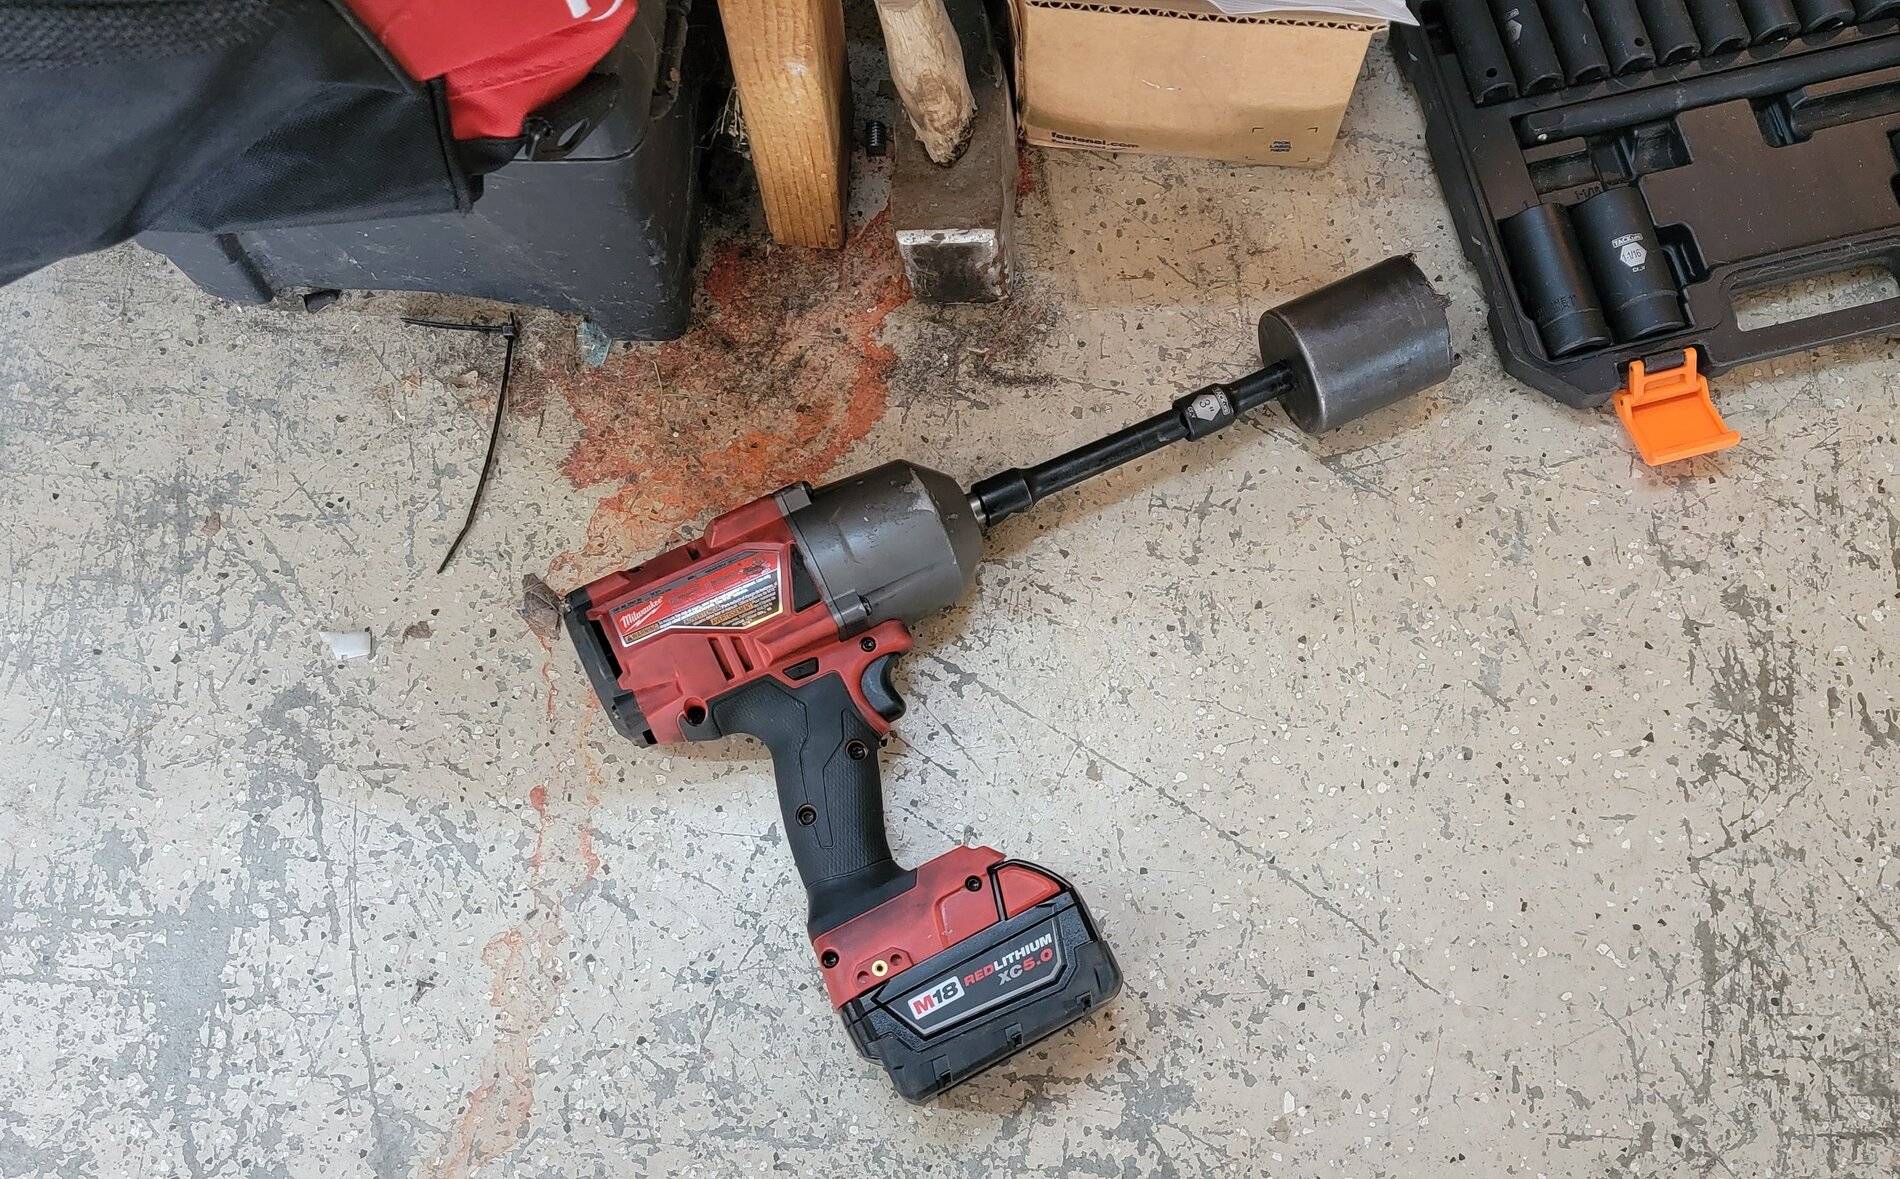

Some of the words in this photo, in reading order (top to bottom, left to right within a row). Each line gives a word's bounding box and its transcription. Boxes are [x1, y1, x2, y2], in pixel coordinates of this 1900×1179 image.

[1051, 131, 1139, 148] fastenal.com
[619, 597, 662, 628] Milwaukee
[912, 981, 959, 1015] M18
[963, 933, 1053, 987] REDLITHIUM
